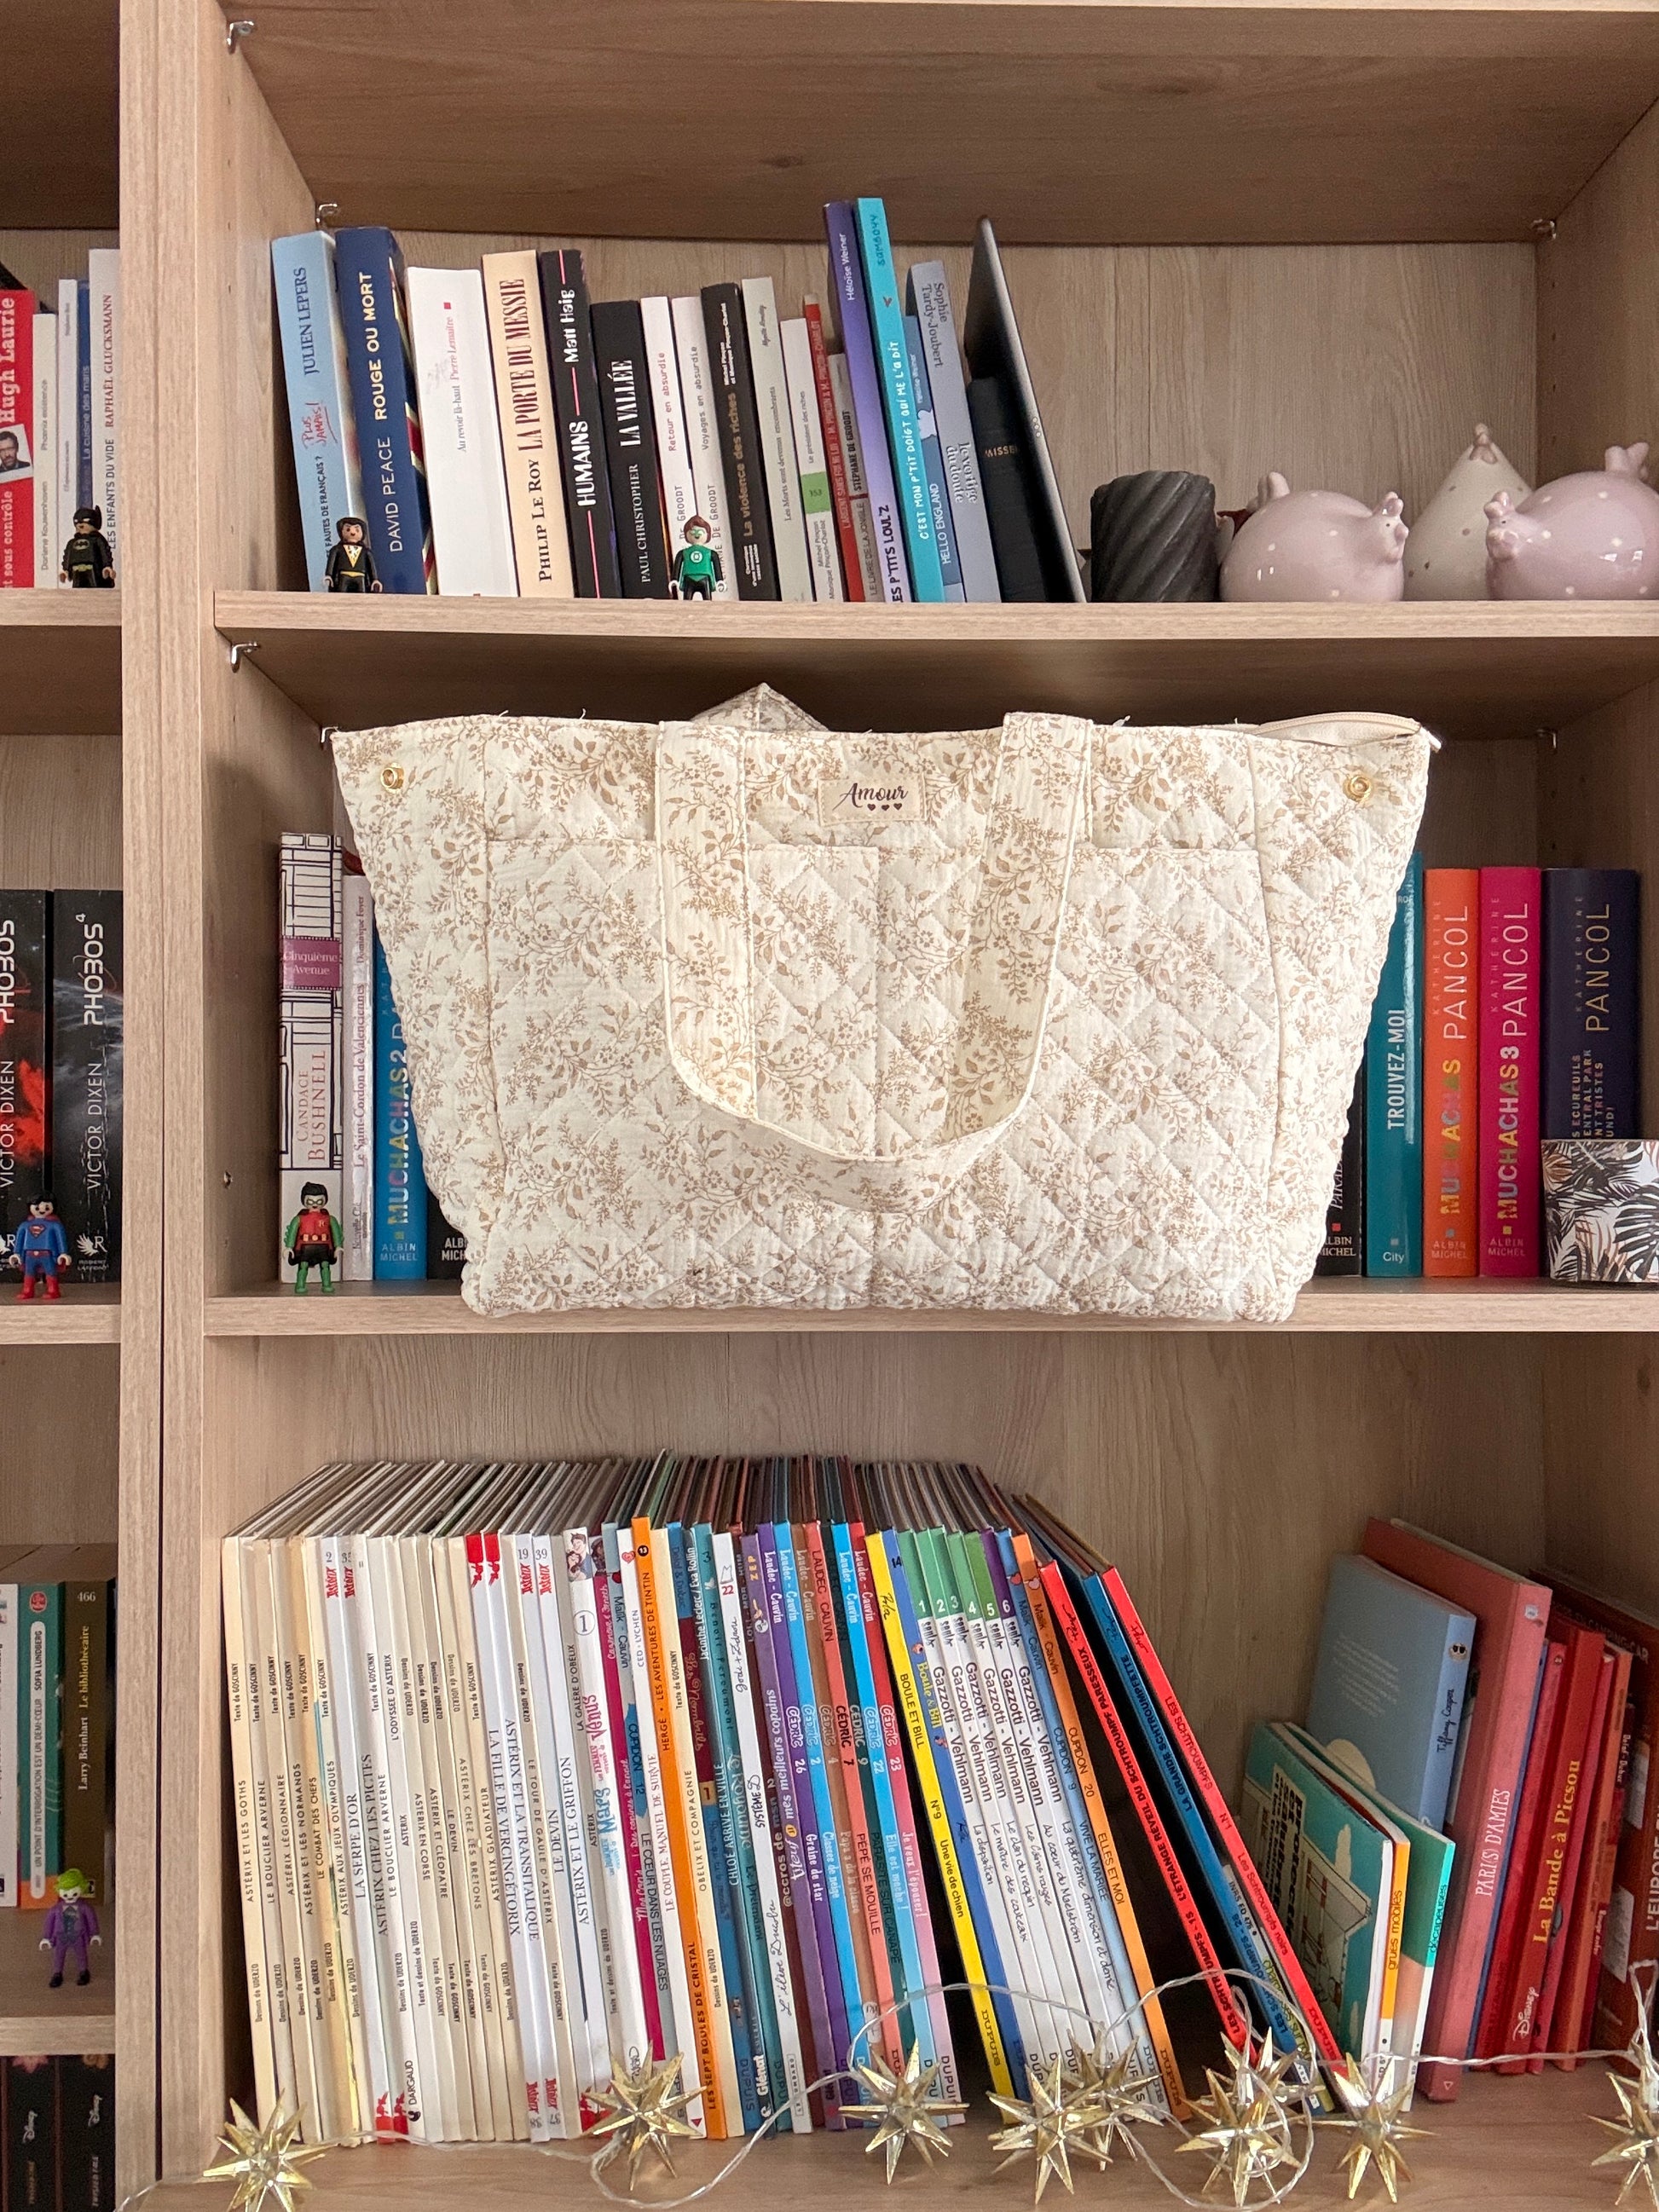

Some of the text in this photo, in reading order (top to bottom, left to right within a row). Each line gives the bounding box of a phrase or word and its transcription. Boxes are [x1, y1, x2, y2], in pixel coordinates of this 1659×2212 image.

[293, 267, 321, 375] JULIEN LEPERS
[359, 272, 387, 420] ROUGE OU MORT
[558, 290, 580, 363] Matt Haig
[922, 283, 944, 368] Tardy-Joubert
[934, 282, 949, 323] Sophie
[102, 295, 114, 428] RAPHAËL GLUCKSMANN
[500, 279, 544, 451] LA PORTE DU MESSIE
[606, 360, 641, 447] LA VALLÉE
[658, 352, 678, 452] Retour en absurdie
[690, 346, 710, 451] Voyages en absurdie
[104, 439, 114, 461] VIDE
[105, 465, 115, 478] DU
[315, 462, 328, 505] FRANÇAIS
[377, 437, 402, 552] DAVID PEACE
[569, 420, 597, 506] HUMAINS
[727, 392, 754, 537] La violence des riches
[841, 410, 862, 492] STÉPHANE DE GROODT
[1, 482, 14, 576] sous contrôle
[106, 481, 116, 528] ENFANTS
[321, 505, 329, 517] DE
[321, 518, 333, 547] FAUTES
[528, 459, 552, 582] PHILIP LE ROY
[628, 464, 651, 583] PAUL CHRISTOPHER
[674, 484, 686, 522] GROODT
[708, 483, 720, 521] GROODT
[711, 527, 721, 539] DE
[877, 504, 899, 584] P'TITS LOUL'Z
[929, 483, 951, 565] HELLO ENGLAND
[832, 783, 909, 811] Amour
[293, 964, 331, 975] Avenue
[356, 919, 367, 964] Dominique
[1432, 898, 1442, 1016] KATHERINE
[1443, 906, 1468, 1040] PANCOL
[1491, 897, 1500, 1013] KATHERINE
[1502, 904, 1529, 1037] PANCOL
[1574, 895, 1582, 1012] KATHERINE
[1585, 904, 1610, 1032] PANCOL
[352, 984, 366, 1168] Le Saint-Cordon de Valenciennes
[390, 1049, 408, 1064] 2
[1388, 1008, 1406, 1129] TROUVEZ-MOI
[1571, 1054, 1581, 1126] ECUREUILS
[1594, 1062, 1604, 1116] TRISTES
[0, 1060, 14, 1188] VICTOR DIXEN
[87, 1062, 102, 1190] VICTOR DIXEN
[297, 1070, 309, 1142] CANDACE
[308, 1050, 326, 1161] BUSHNELL
[387, 1067, 409, 1225] MUCHACHAS
[1441, 1058, 1461, 1213] MUCHACHAS
[1497, 1045, 1519, 1219] MUCHACHAS 3
[380, 1252, 418, 1262] MICHEL
[382, 1243, 416, 1252] ALBIN
[1383, 1250, 1405, 1263] City
[812, 1551, 835, 1642] LAUDEC CAUVIN
[33, 1630, 43, 1691] SOFIA LUNDBERG
[78, 1626, 90, 1708] Le bibliothécaire
[642, 1572, 671, 1752] HERGÉ LES AVENTURES DE TINTIN
[77, 1717, 90, 1790] Larry Beinhart
[787, 1706, 803, 1748] CÉDRIC
[835, 1705, 852, 1748] CÉDRIC
[934, 1666, 974, 1805] Gazzotti Vehlmann
[951, 1666, 993, 1803] Gazzotti Vehlmann
[965, 1662, 1009, 1799] Gazzotti Vehlmann
[983, 1668, 1027, 1804] Gazzotti Vehlmann
[1001, 1668, 1046, 1806] Gazzotti Vehlmann
[1018, 1666, 1064, 1803] Gazzotti Vehlmann
[1436, 1689, 1457, 1753] Tiffany Cooper
[257, 1780, 275, 1904] LE BOUCLIER ARVERNE
[346, 1793, 367, 1898] LA SERPE D'OR
[361, 1753, 389, 1937] ASTÉRIX CHEZ LES PICTES
[488, 1730, 521, 1936] LA FILLE DE VERCINGÉTORIX
[505, 1718, 540, 1943] ASTÉRIX ET LA TRANSITALIQUE
[546, 1809, 564, 1874] LE DEVIN
[559, 1757, 590, 1926] ASTÉRIX ET LE GRIFFON
[1475, 1788, 1511, 1897] PARI(S) D'AMIES
[1533, 1760, 1581, 1944] La Bande à Picsou
[1386, 1888, 1402, 1972] grues mobiles
[1428, 1884, 1448, 1954] décapeuses
[1512, 1986, 1540, 2041] Disney
[405, 2060, 417, 2106] DARGAUD
[753, 2053, 769, 2096] Glénat
